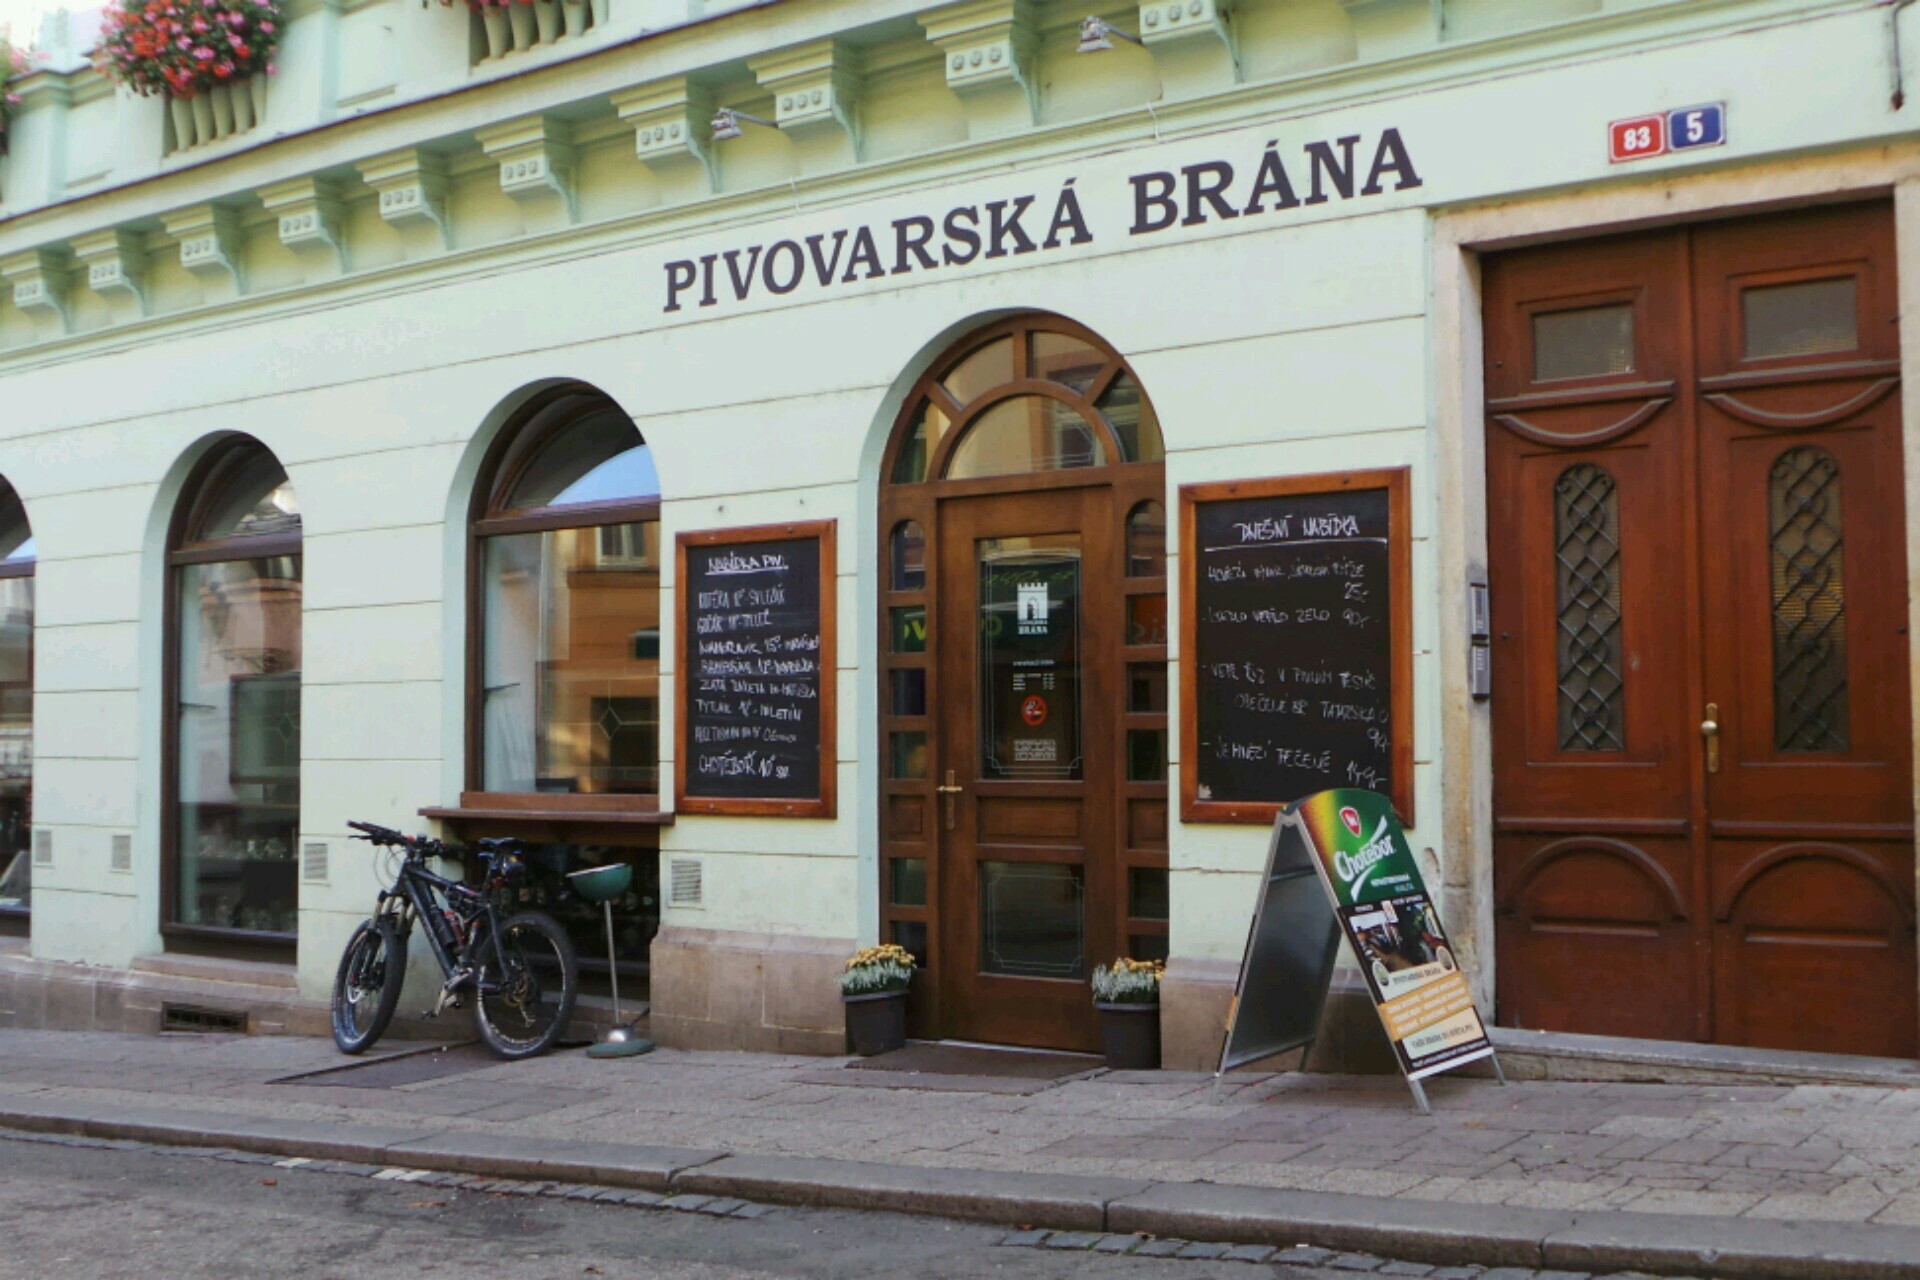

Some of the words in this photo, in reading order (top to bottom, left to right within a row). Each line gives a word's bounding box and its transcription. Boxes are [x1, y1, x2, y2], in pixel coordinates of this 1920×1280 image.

[1623, 126, 1651, 150] 83
[1686, 112, 1703, 142] 5
[663, 178, 1092, 312] PIVOVARSKÁ
[1129, 127, 1423, 236] BRÁNA
